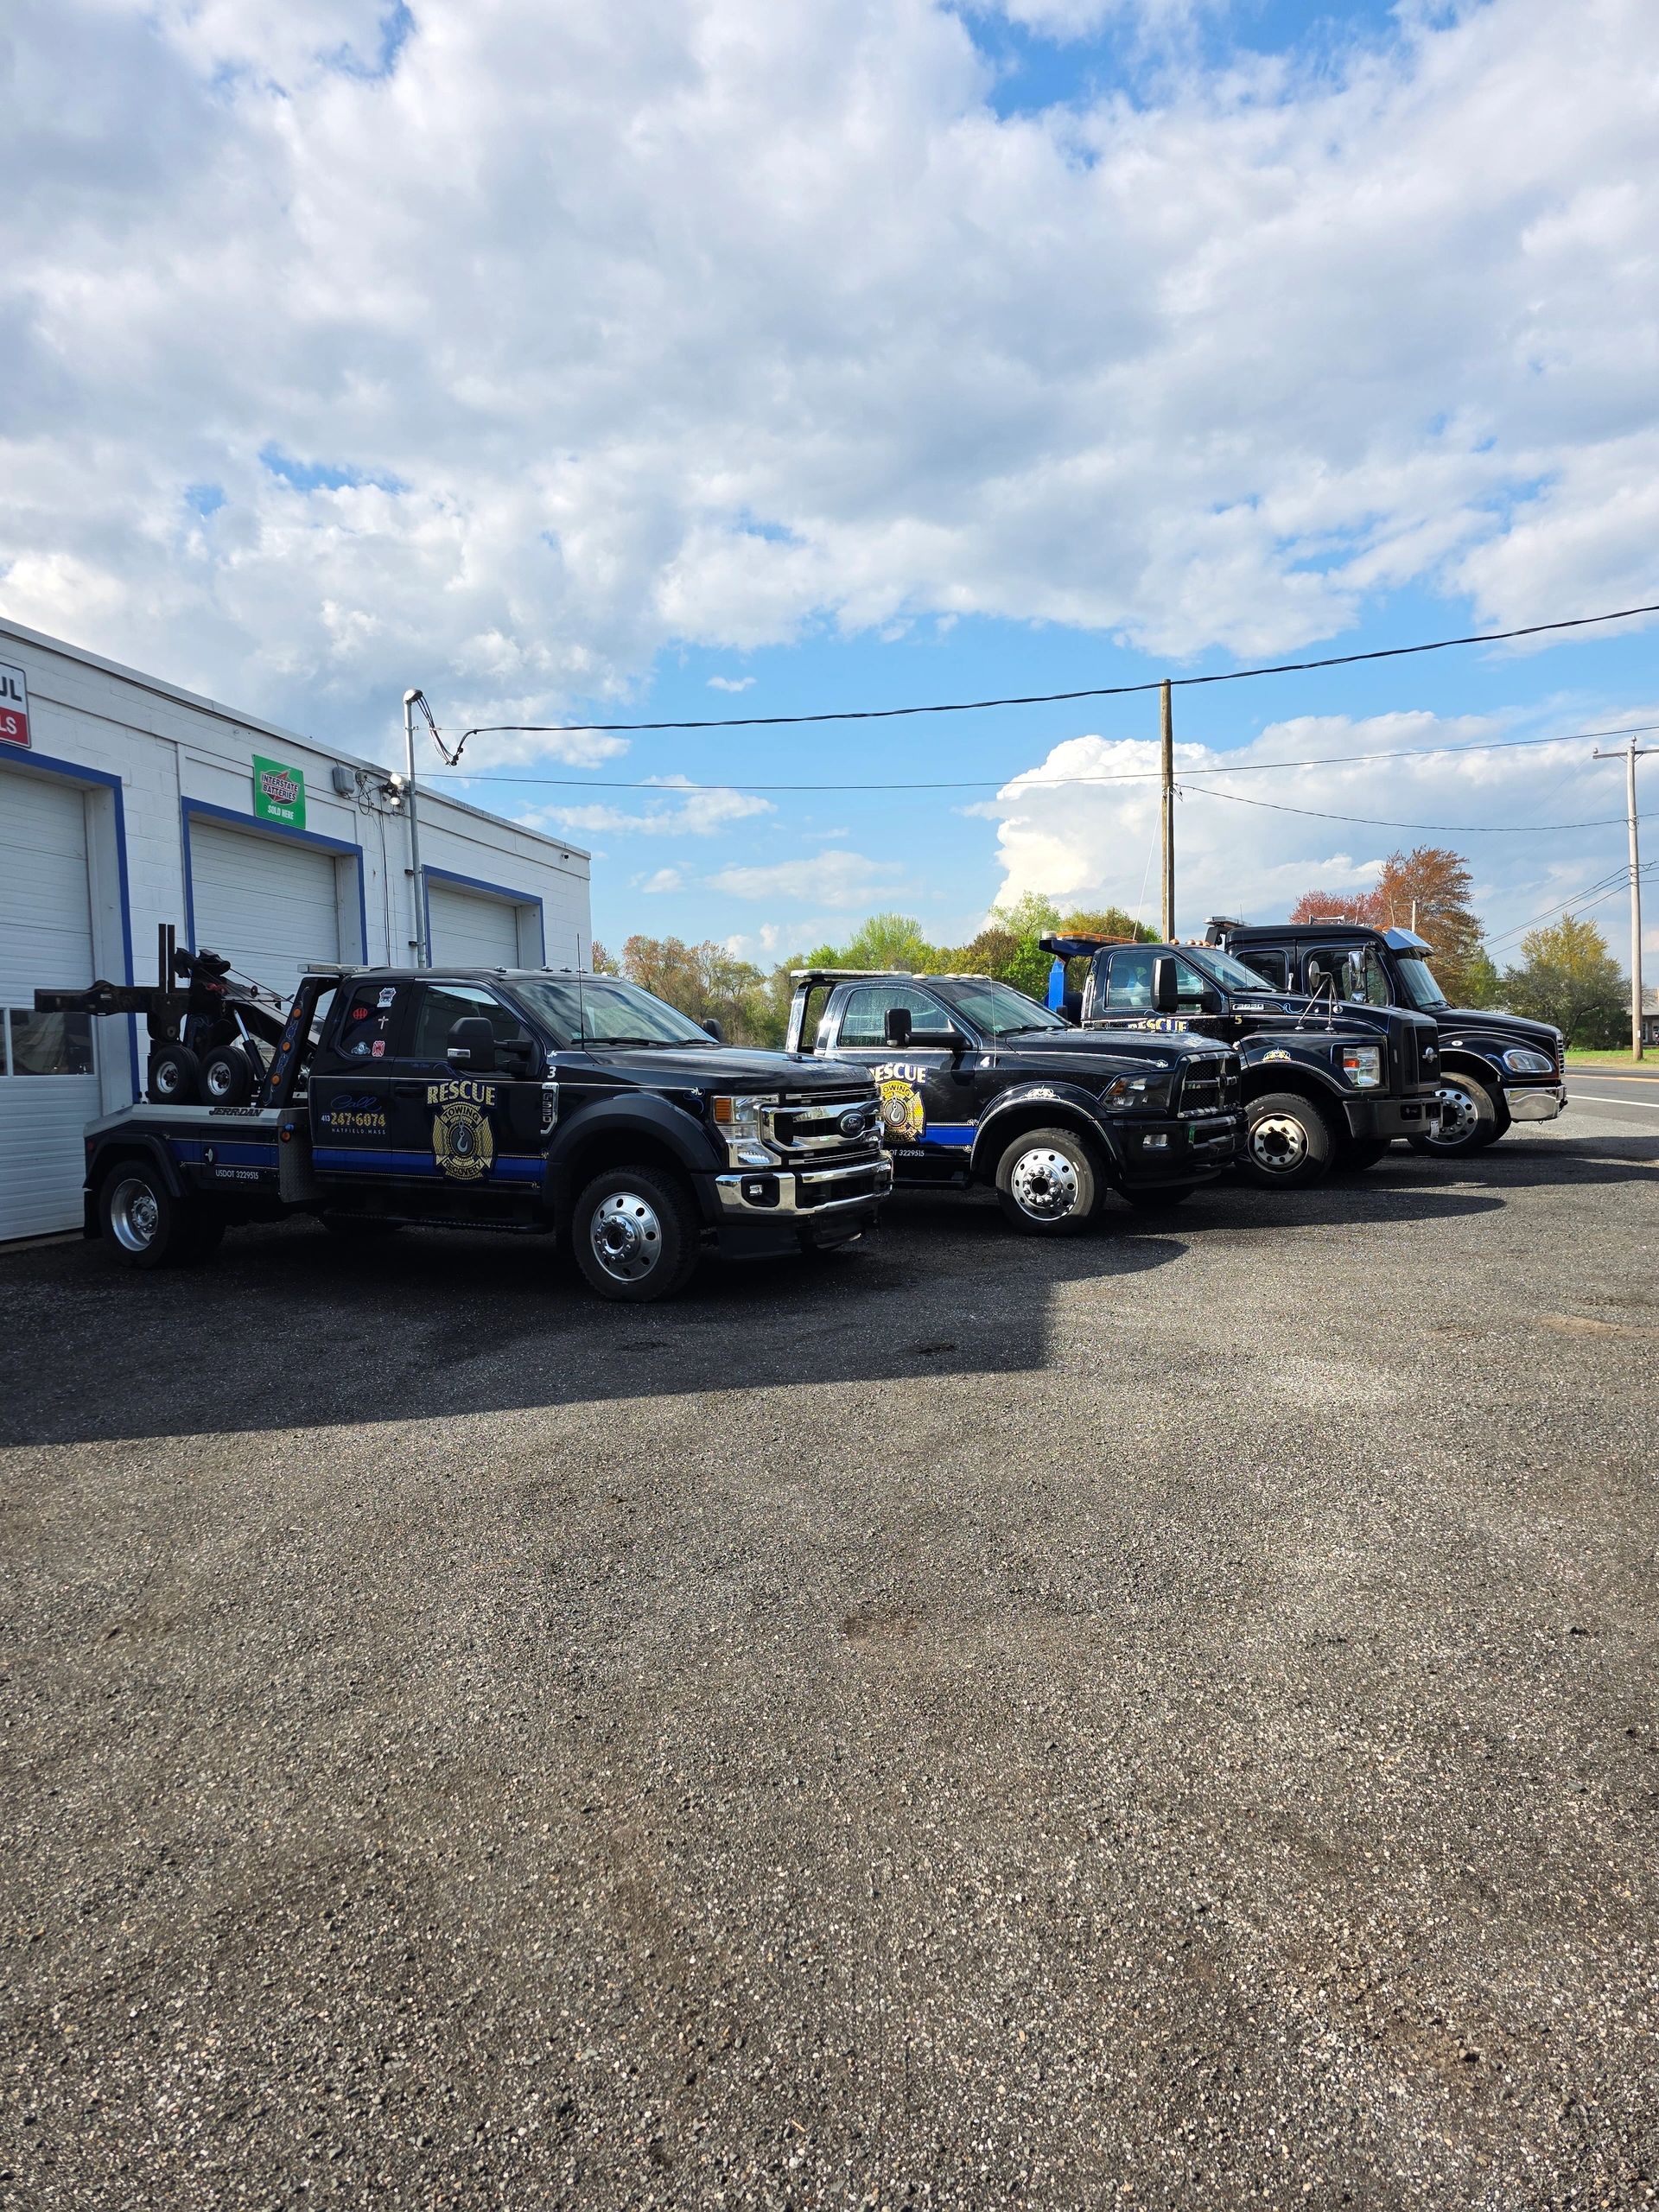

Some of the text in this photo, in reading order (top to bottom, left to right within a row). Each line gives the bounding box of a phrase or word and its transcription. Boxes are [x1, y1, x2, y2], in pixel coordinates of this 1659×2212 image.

[262, 773, 298, 792] INTERSTATE
[263, 784, 296, 801] BATTERIES
[268, 804, 294, 820] SOLD HERE
[1234, 1014, 1243, 1025] 5
[980, 1056, 990, 1068] 4
[547, 1065, 556, 1079] 3
[427, 1080, 496, 1106] RESCUE
[330, 1094, 382, 1112] Call
[443, 1105, 480, 1122] TOWING
[215, 1169, 259, 1179] USDOT 3229515
[443, 1160, 481, 1175] RECOVERY
